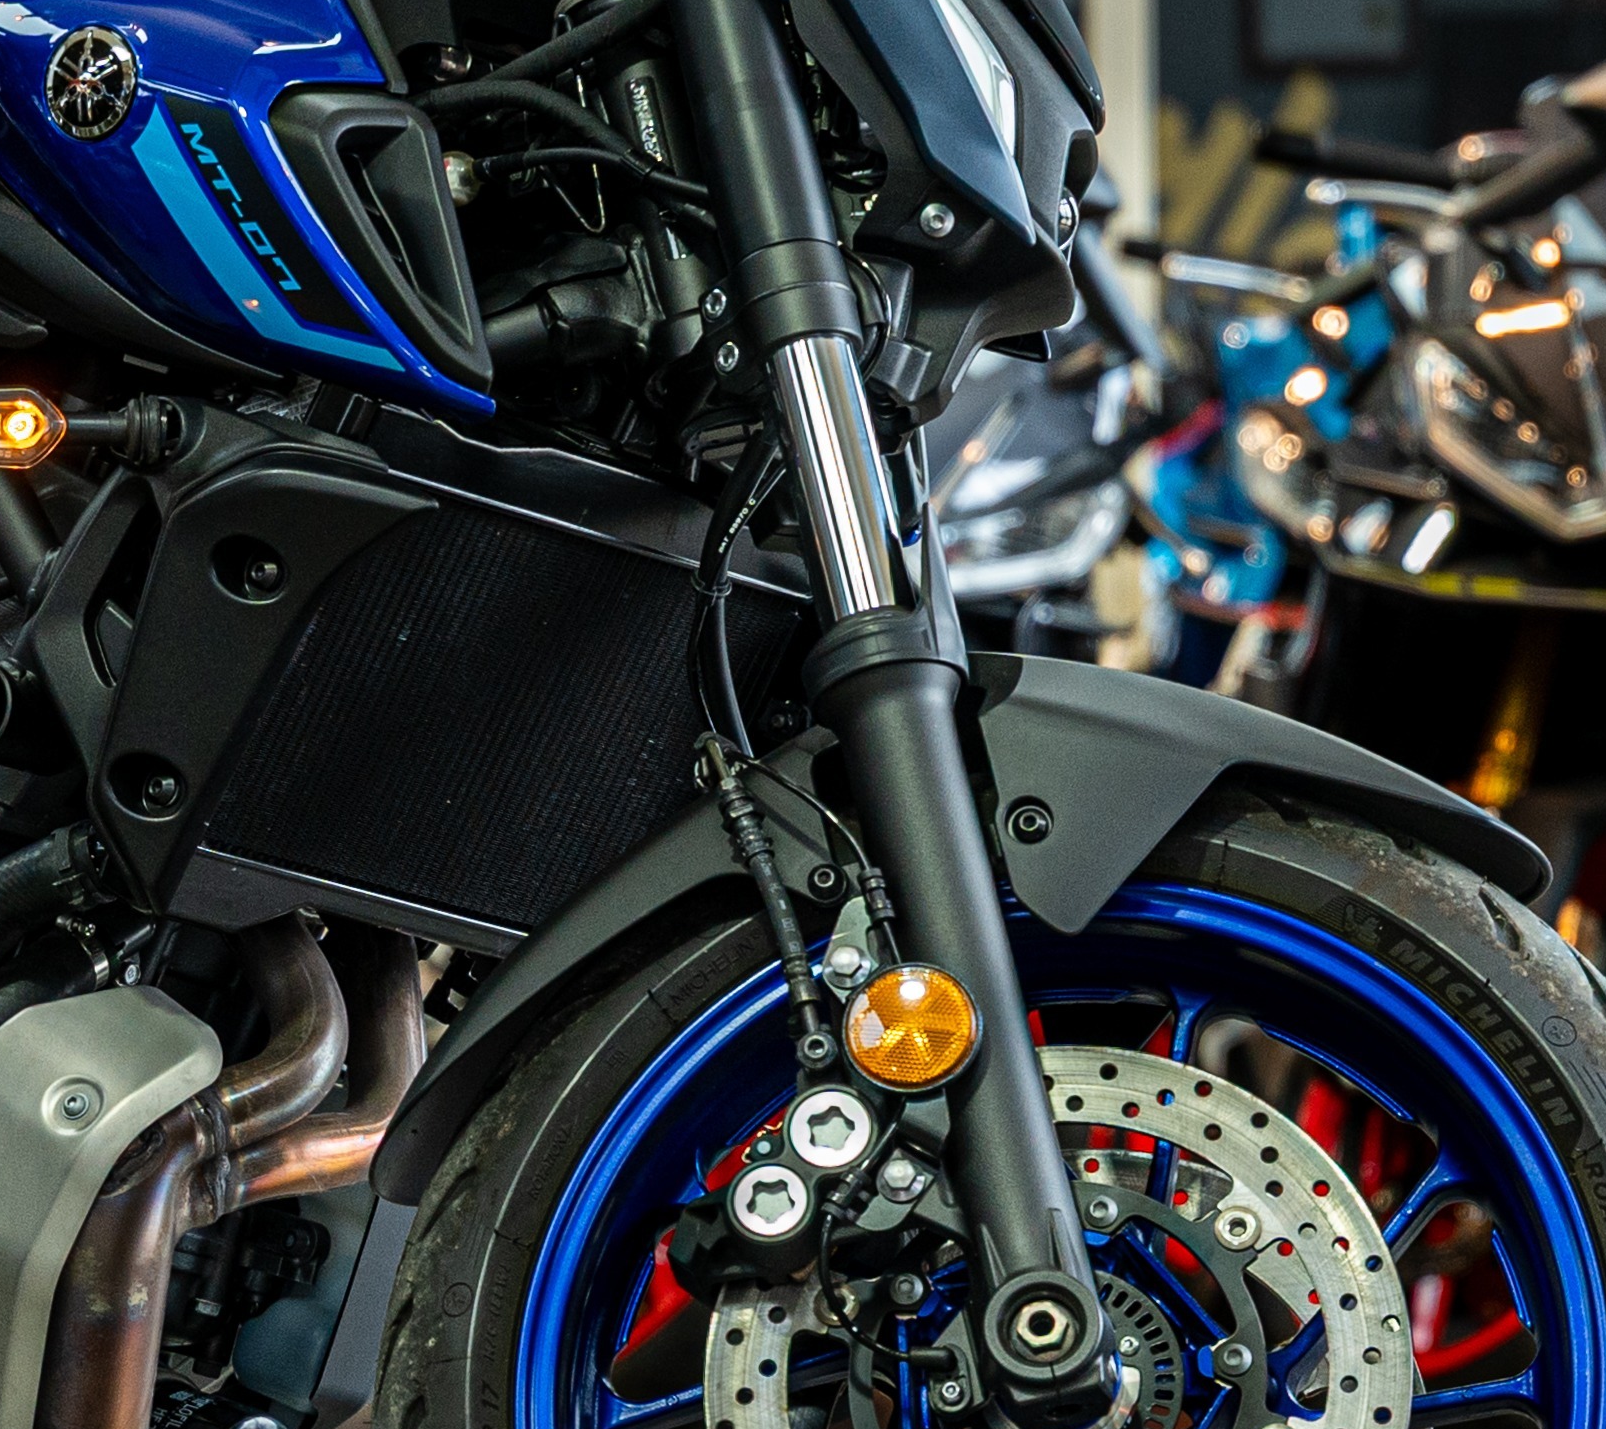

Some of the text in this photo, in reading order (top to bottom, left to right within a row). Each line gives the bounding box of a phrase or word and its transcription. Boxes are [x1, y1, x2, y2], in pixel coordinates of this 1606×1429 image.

[178, 121, 302, 293] MT-07
[1390, 936, 1577, 1123] MICHELIN
[480, 1380, 500, 1410] 17
